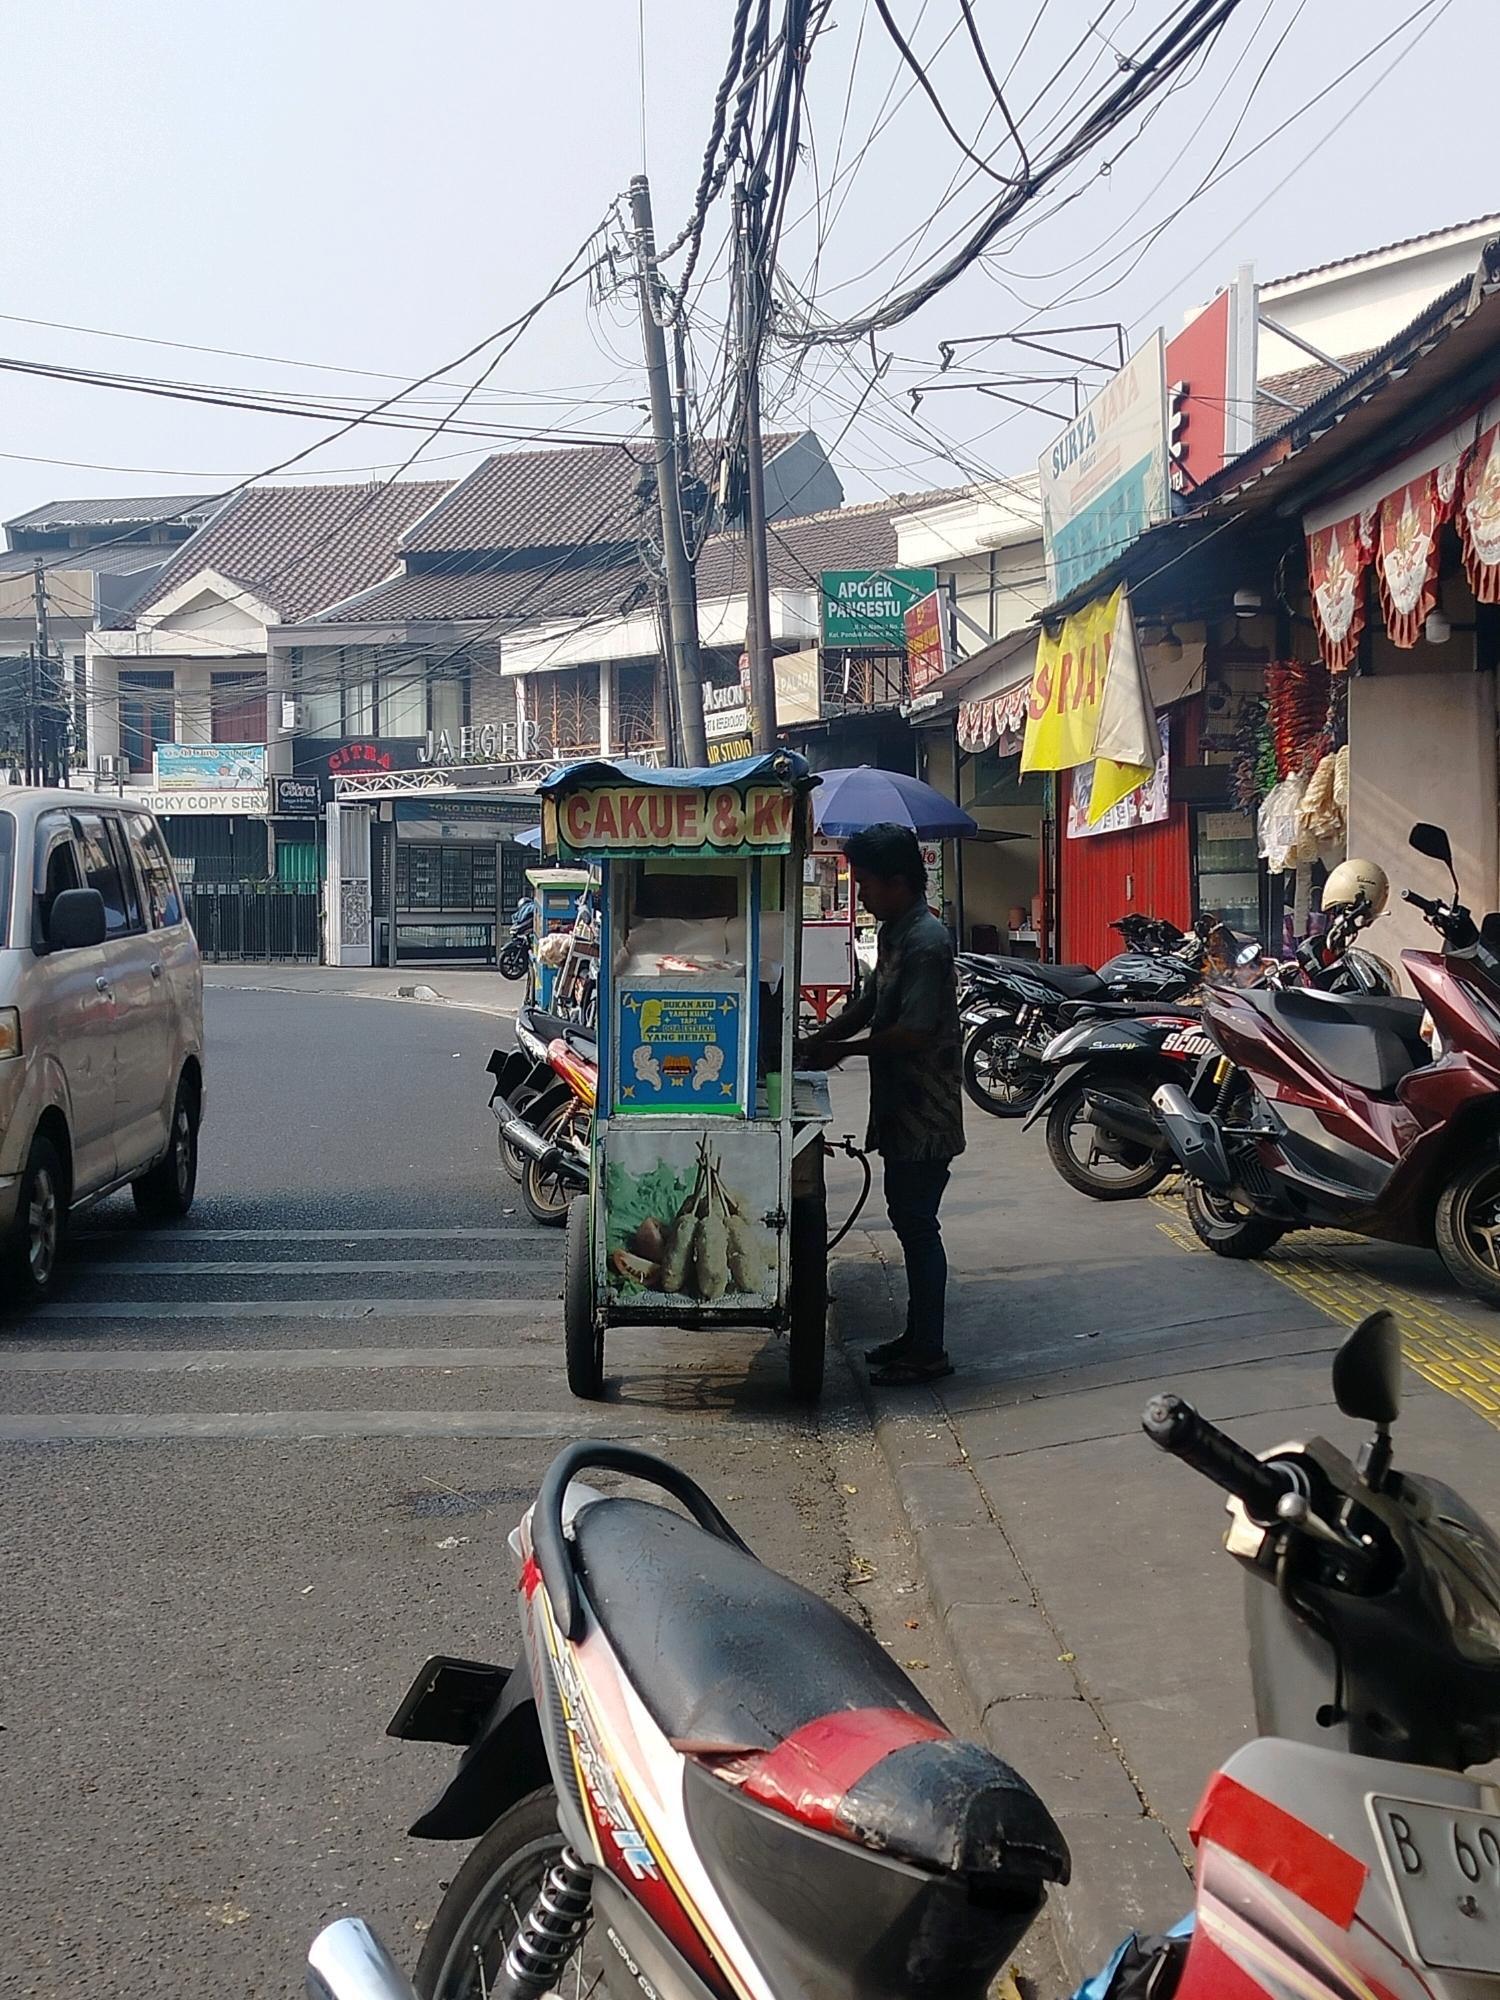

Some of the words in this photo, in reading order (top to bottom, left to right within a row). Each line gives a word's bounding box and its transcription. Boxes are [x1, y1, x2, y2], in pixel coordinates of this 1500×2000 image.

[1052, 410, 1097, 480] SURYA
[1099, 365, 1140, 433] JAYA
[838, 581, 893, 598] APOTEK
[828, 601, 900, 618] PANGESTU
[780, 670, 815, 691] PALAPA
[713, 685, 744, 708] SALON
[417, 720, 540, 762] JAEGER
[721, 739, 752, 762] STUDIO
[329, 744, 391, 770] CITRA
[280, 782, 316, 797] Citra
[141, 796, 184, 809] DICKY
[187, 796, 228, 809] COPY
[428, 803, 460, 812] TOKO
[464, 804, 507, 814] LISTRIK
[567, 794, 698, 840] CAKUE
[712, 794, 739, 837] &
[1089, 1041, 1139, 1050] Scoopy
[1388, 1812, 1423, 1875] B
[607, 1927, 638, 1975] ECONO
